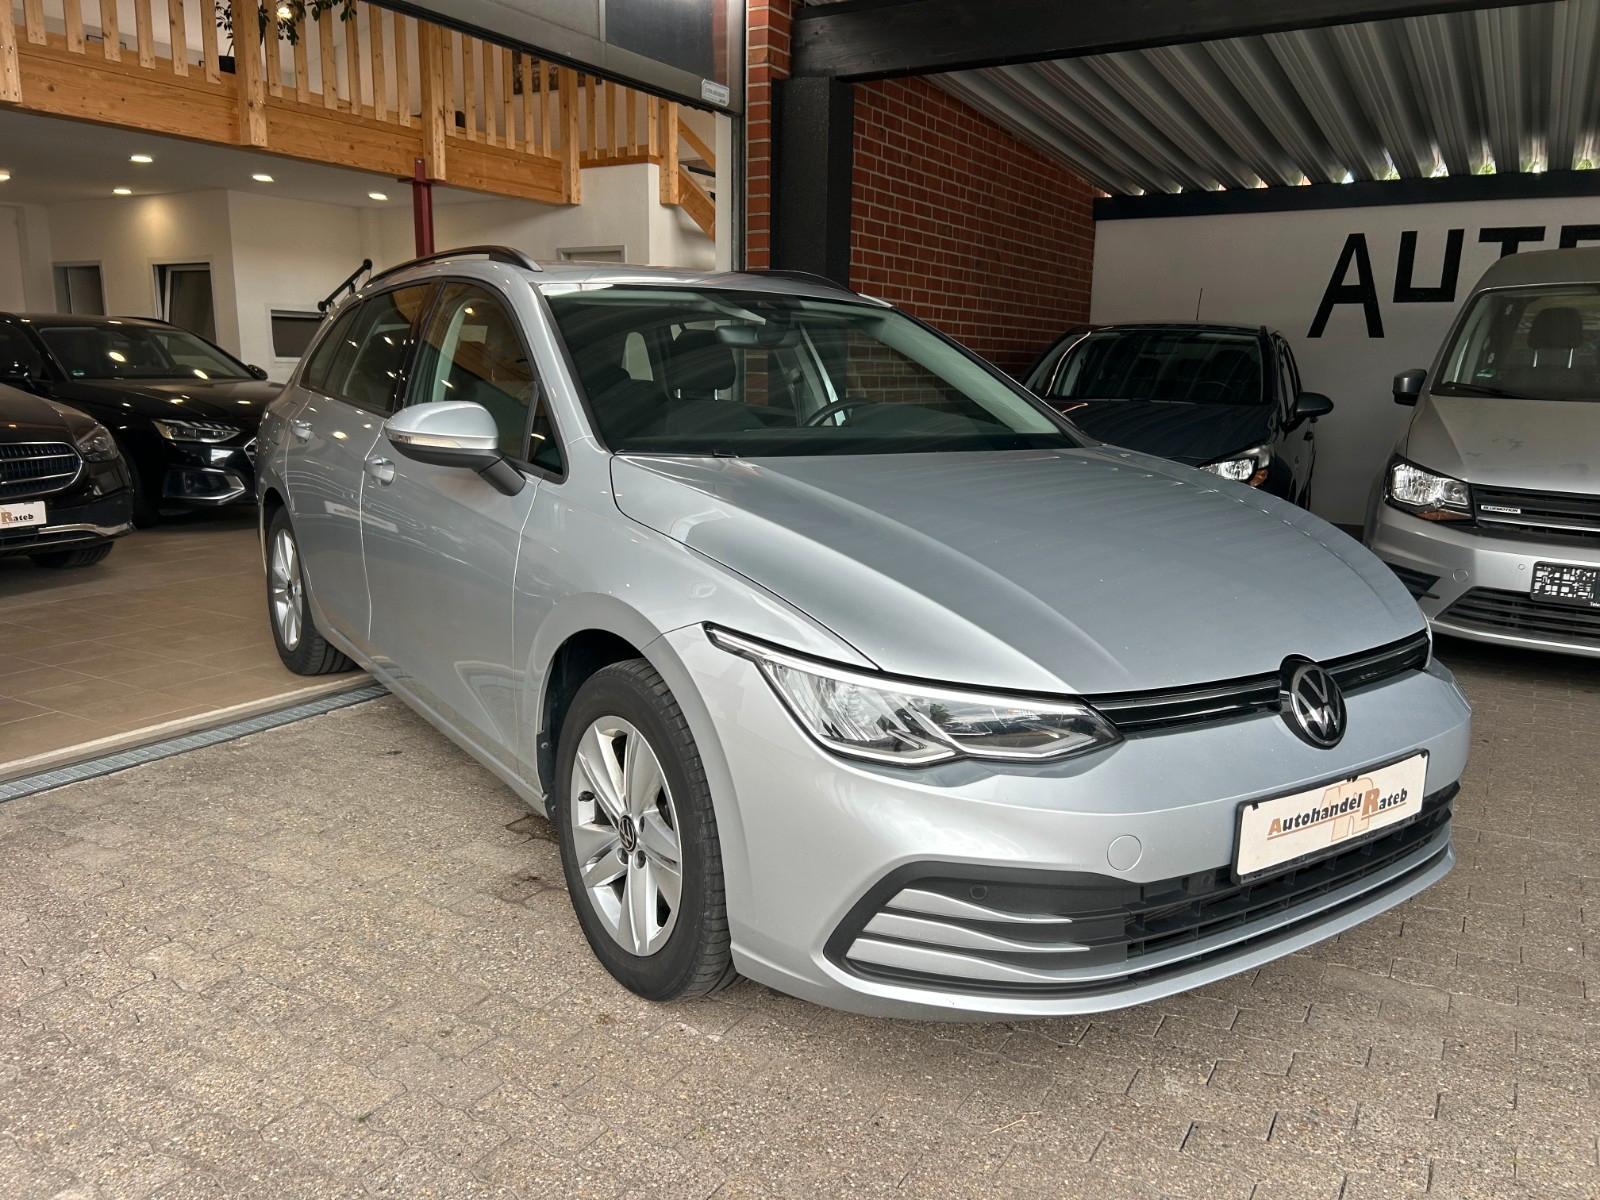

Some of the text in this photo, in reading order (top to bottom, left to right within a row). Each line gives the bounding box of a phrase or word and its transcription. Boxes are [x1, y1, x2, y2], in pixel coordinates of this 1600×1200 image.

[1, 512, 34, 522] Rateb
[1268, 788, 1408, 836] Autohandel Rateb
